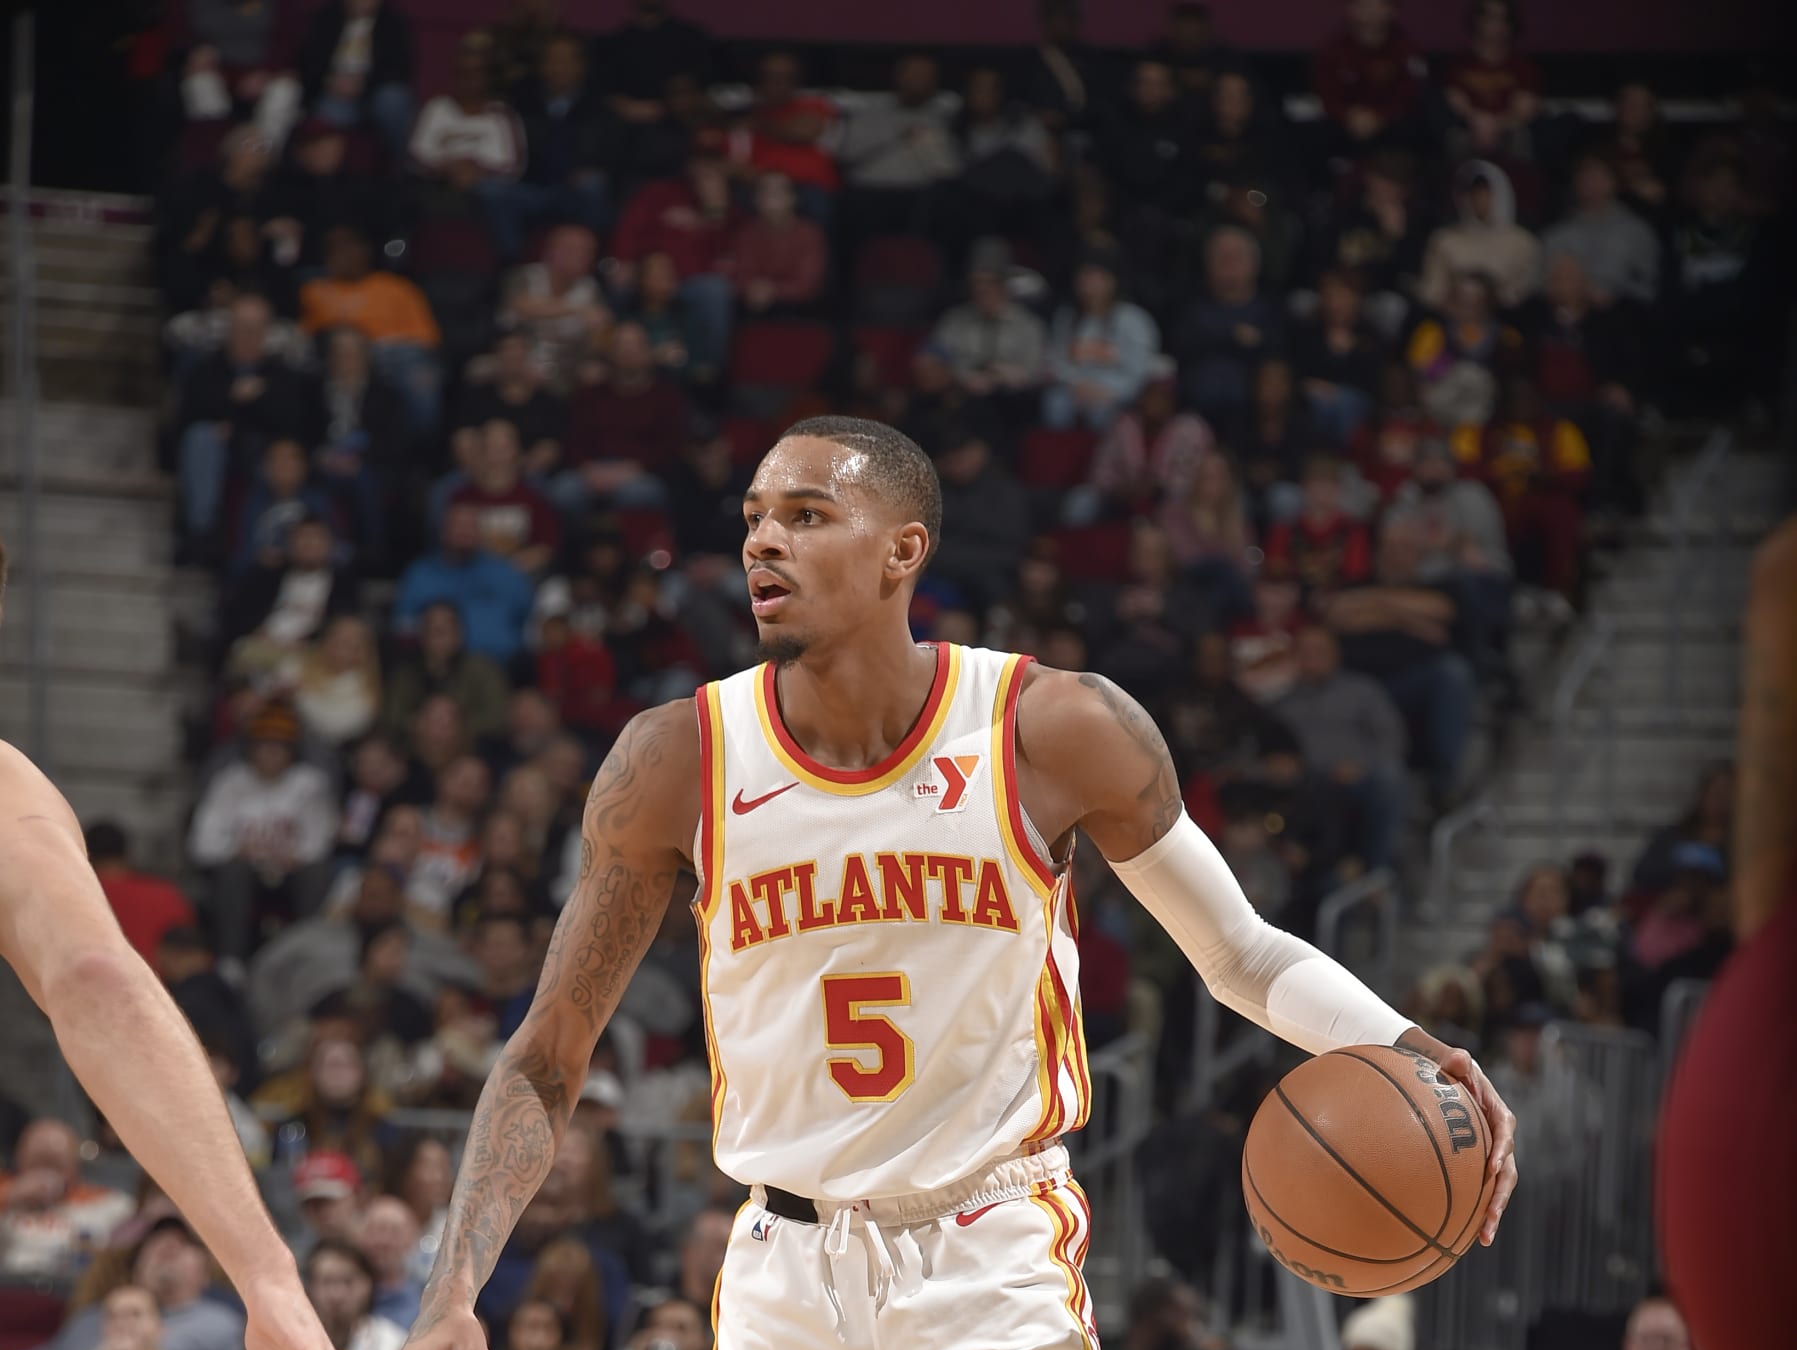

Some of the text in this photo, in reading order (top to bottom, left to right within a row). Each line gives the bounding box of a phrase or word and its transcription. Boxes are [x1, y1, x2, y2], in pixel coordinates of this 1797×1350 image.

[917, 783, 938, 795] the
[729, 851, 1021, 953] ATLANTA
[820, 971, 914, 1103] 5
